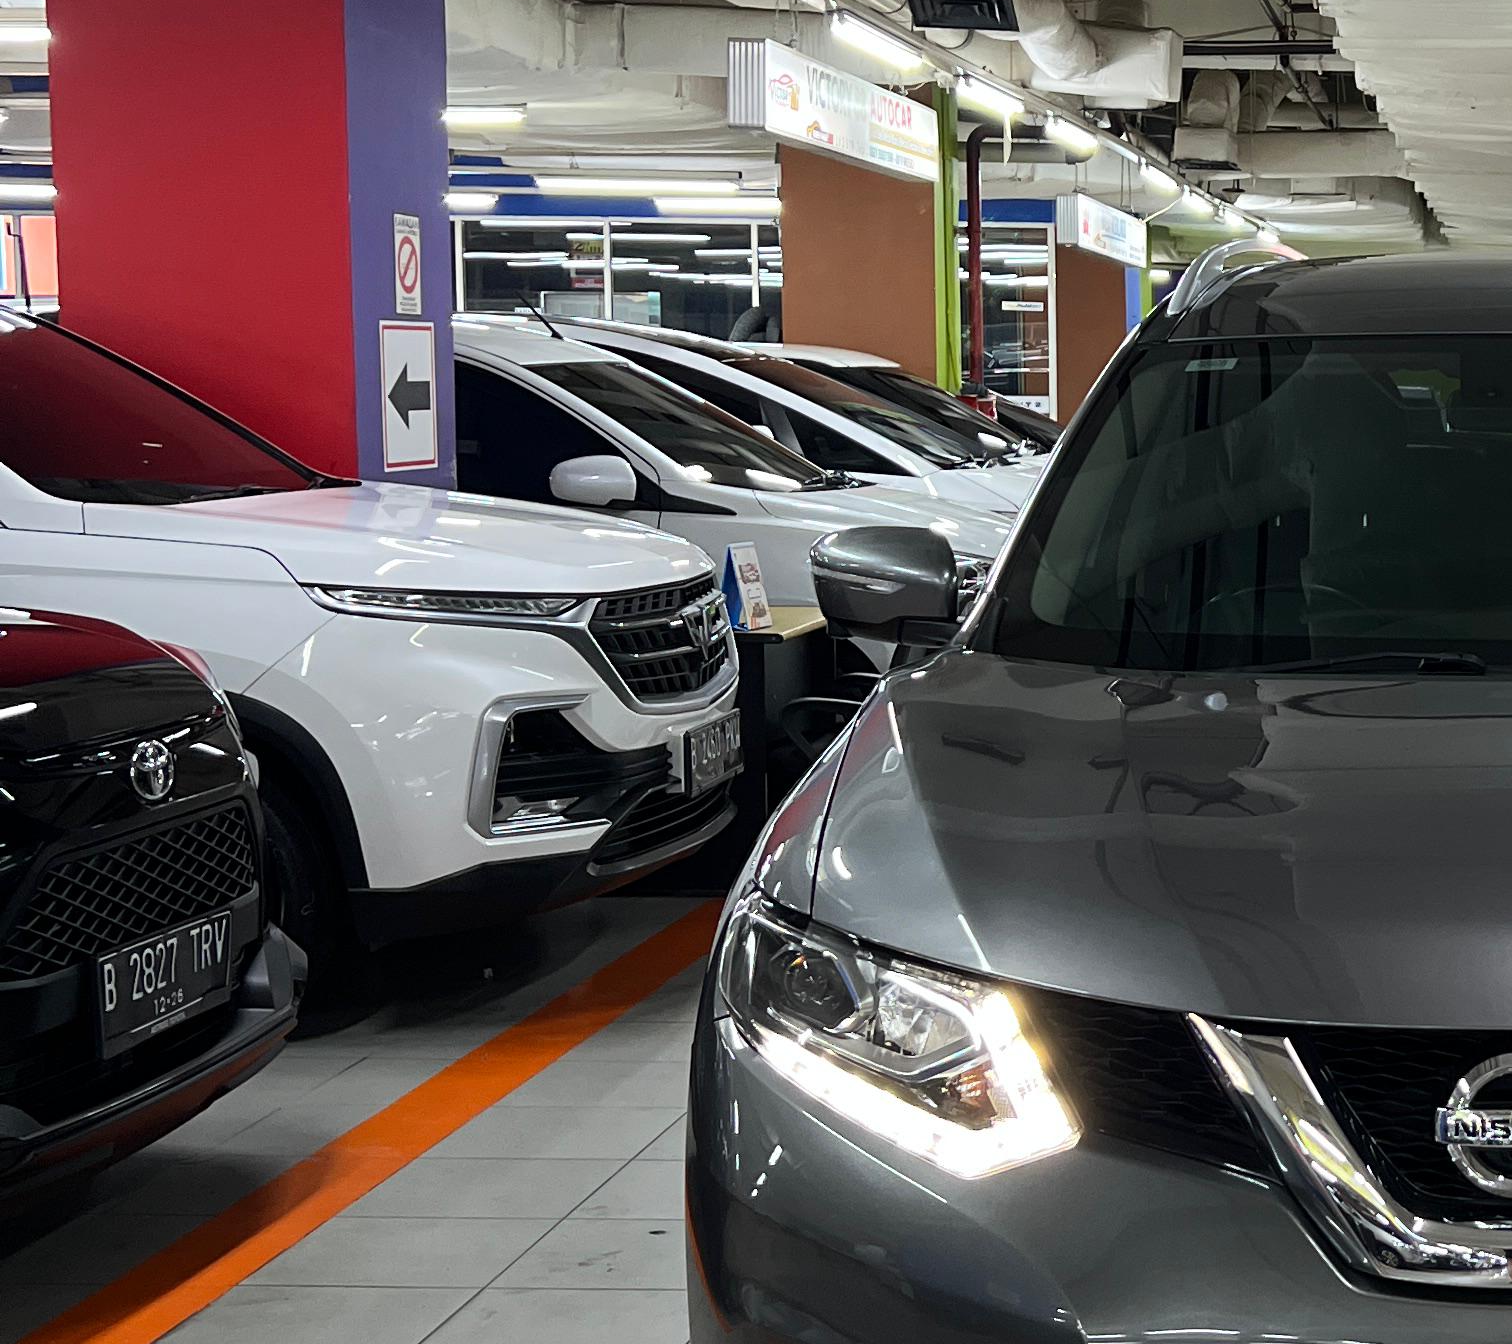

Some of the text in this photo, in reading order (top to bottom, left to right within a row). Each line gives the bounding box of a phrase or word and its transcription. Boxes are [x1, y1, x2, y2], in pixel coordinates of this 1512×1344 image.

[870, 92, 912, 129] AUTOCAR
[104, 918, 227, 1012] B 2827 TRV
